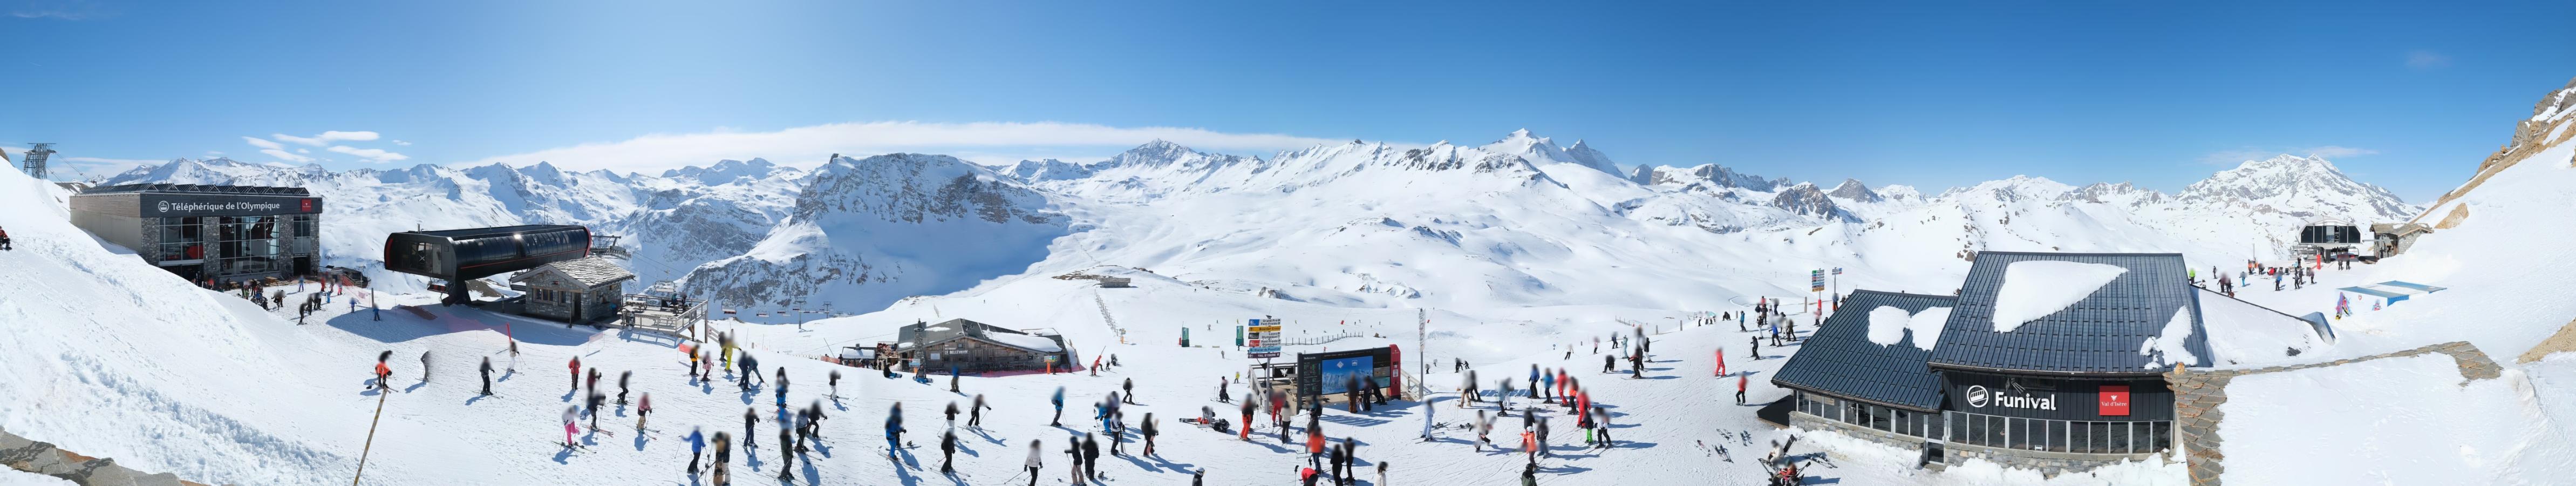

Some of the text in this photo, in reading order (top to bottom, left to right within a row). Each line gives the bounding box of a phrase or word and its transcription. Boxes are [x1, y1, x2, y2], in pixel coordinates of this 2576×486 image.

[171, 202, 224, 213] Téléphérique
[236, 201, 280, 211] l'Olympique
[1995, 391, 2056, 410] Funival
